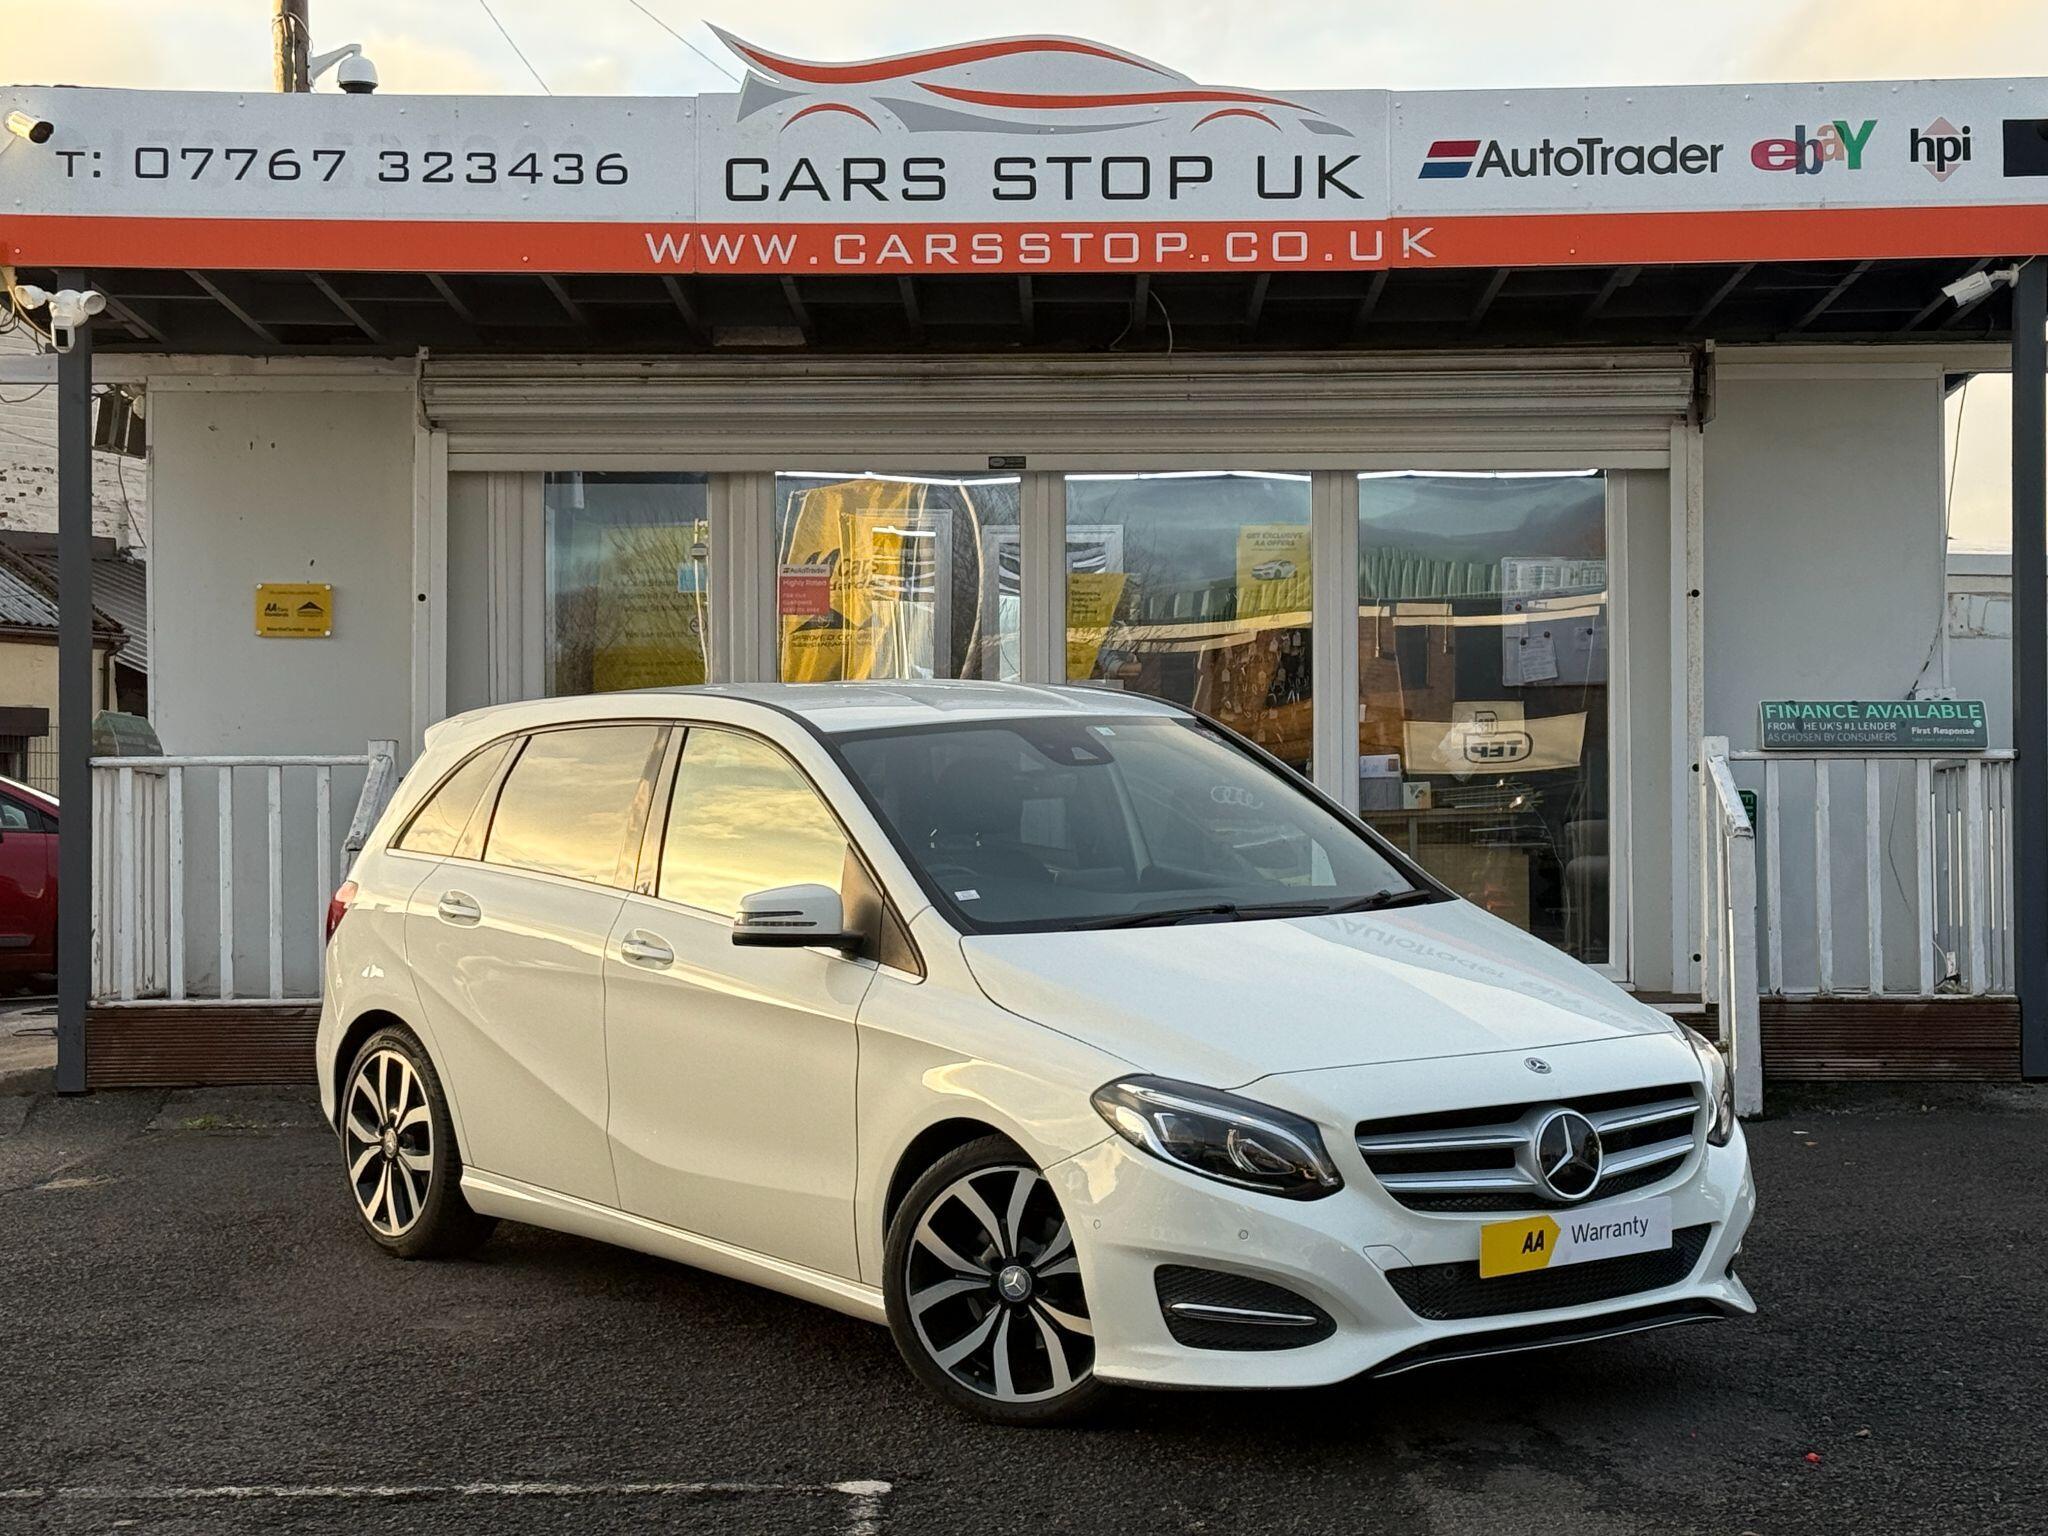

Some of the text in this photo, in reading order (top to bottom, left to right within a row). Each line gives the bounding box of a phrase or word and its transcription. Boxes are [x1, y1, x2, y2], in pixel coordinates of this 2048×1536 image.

[56, 147, 630, 186] T: 07767 323436
[1475, 136, 1725, 180] AutoTrader
[1909, 125, 1973, 173] hpi
[725, 155, 1365, 202] CARS STOP UK
[1765, 704, 1982, 719] FINANCE AVAILABLE
[1767, 722, 1796, 731] FROM
[1801, 722, 1818, 731] HE
[1819, 722, 1843, 731] UK'S
[1858, 722, 1898, 731] LENDER
[1781, 733, 1821, 742] CHOSEN
[1837, 733, 1897, 742] CONSUMERS
[1911, 727, 1976, 736] First Response
[1522, 1215, 1649, 1254] AA Warranty
